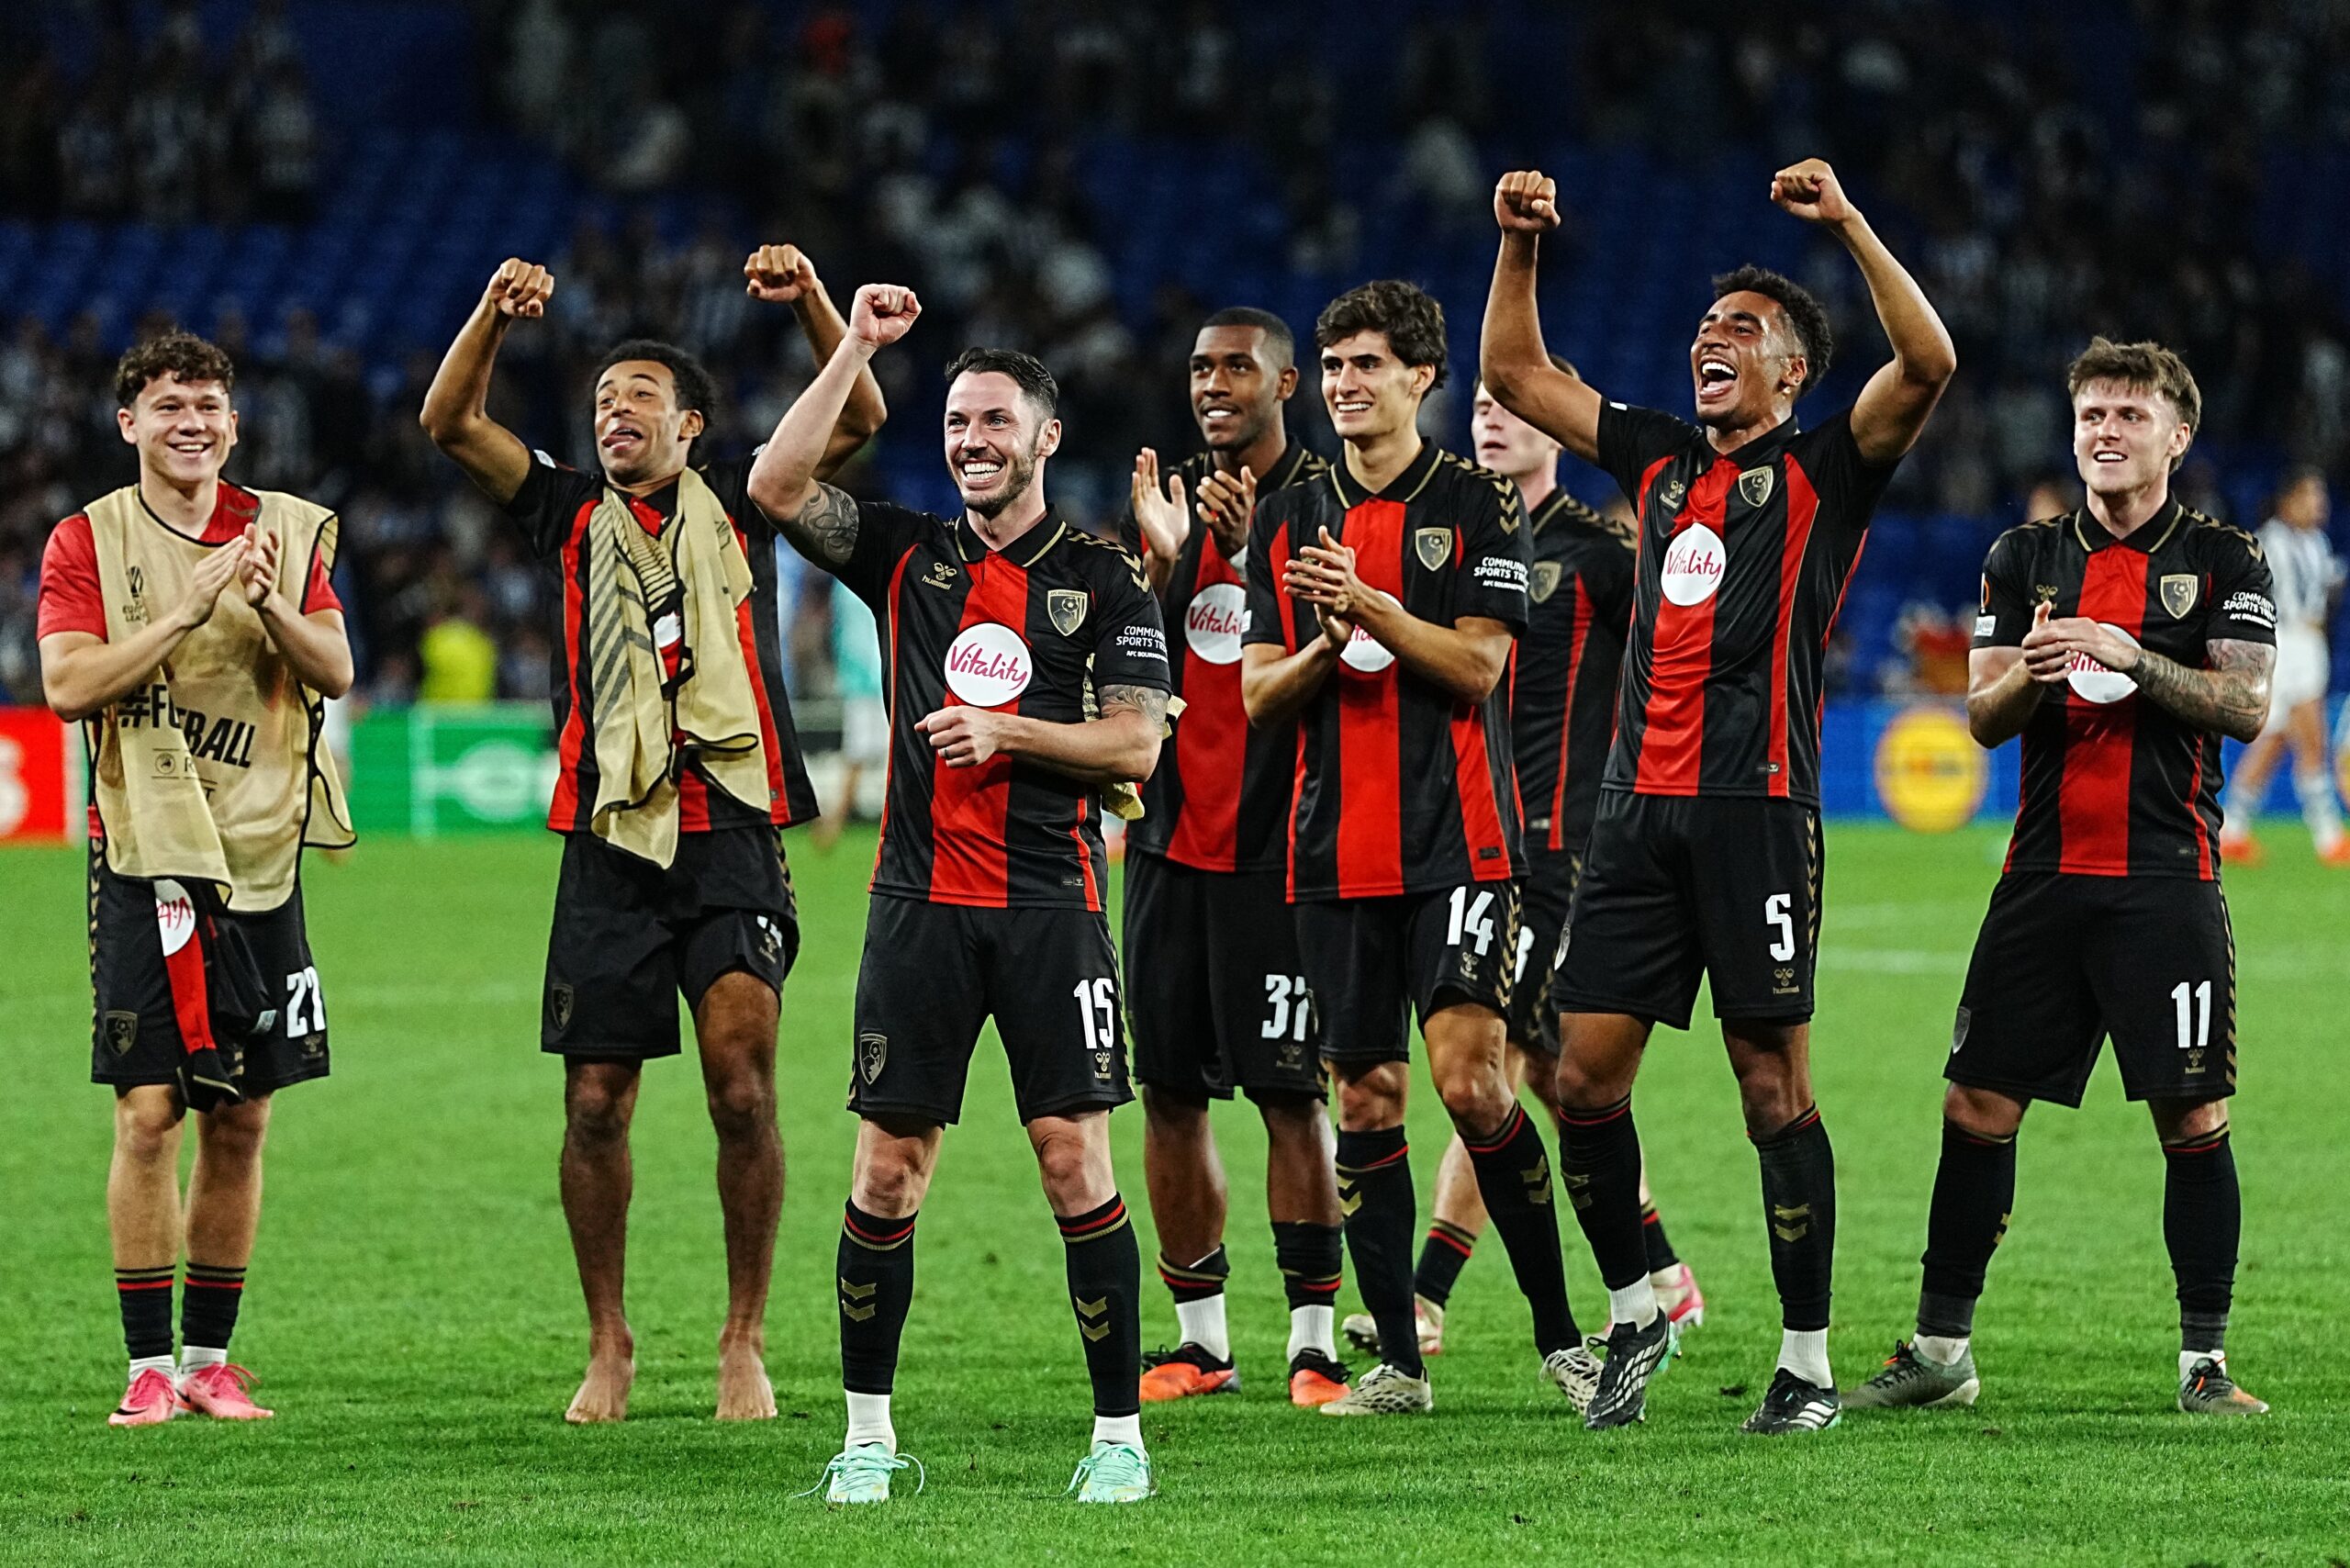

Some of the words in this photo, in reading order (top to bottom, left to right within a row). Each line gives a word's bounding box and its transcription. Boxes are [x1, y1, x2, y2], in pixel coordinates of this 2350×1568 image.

[1473, 566, 1511, 579] SPORTS
[1482, 556, 1528, 576] COMMUNI
[1666, 544, 1722, 586] Vitality
[922, 575, 953, 590] hummel
[1189, 602, 1242, 635] Vitali
[2222, 599, 2259, 613] SPORTS
[1115, 635, 1153, 647] SPORTS
[1124, 625, 1166, 644] COMMUN
[950, 643, 1028, 691] Vitality
[1447, 886, 1494, 956] 14
[1765, 893, 1796, 962] 5
[1073, 978, 1114, 1049] 15
[2171, 980, 2211, 1048] 11
